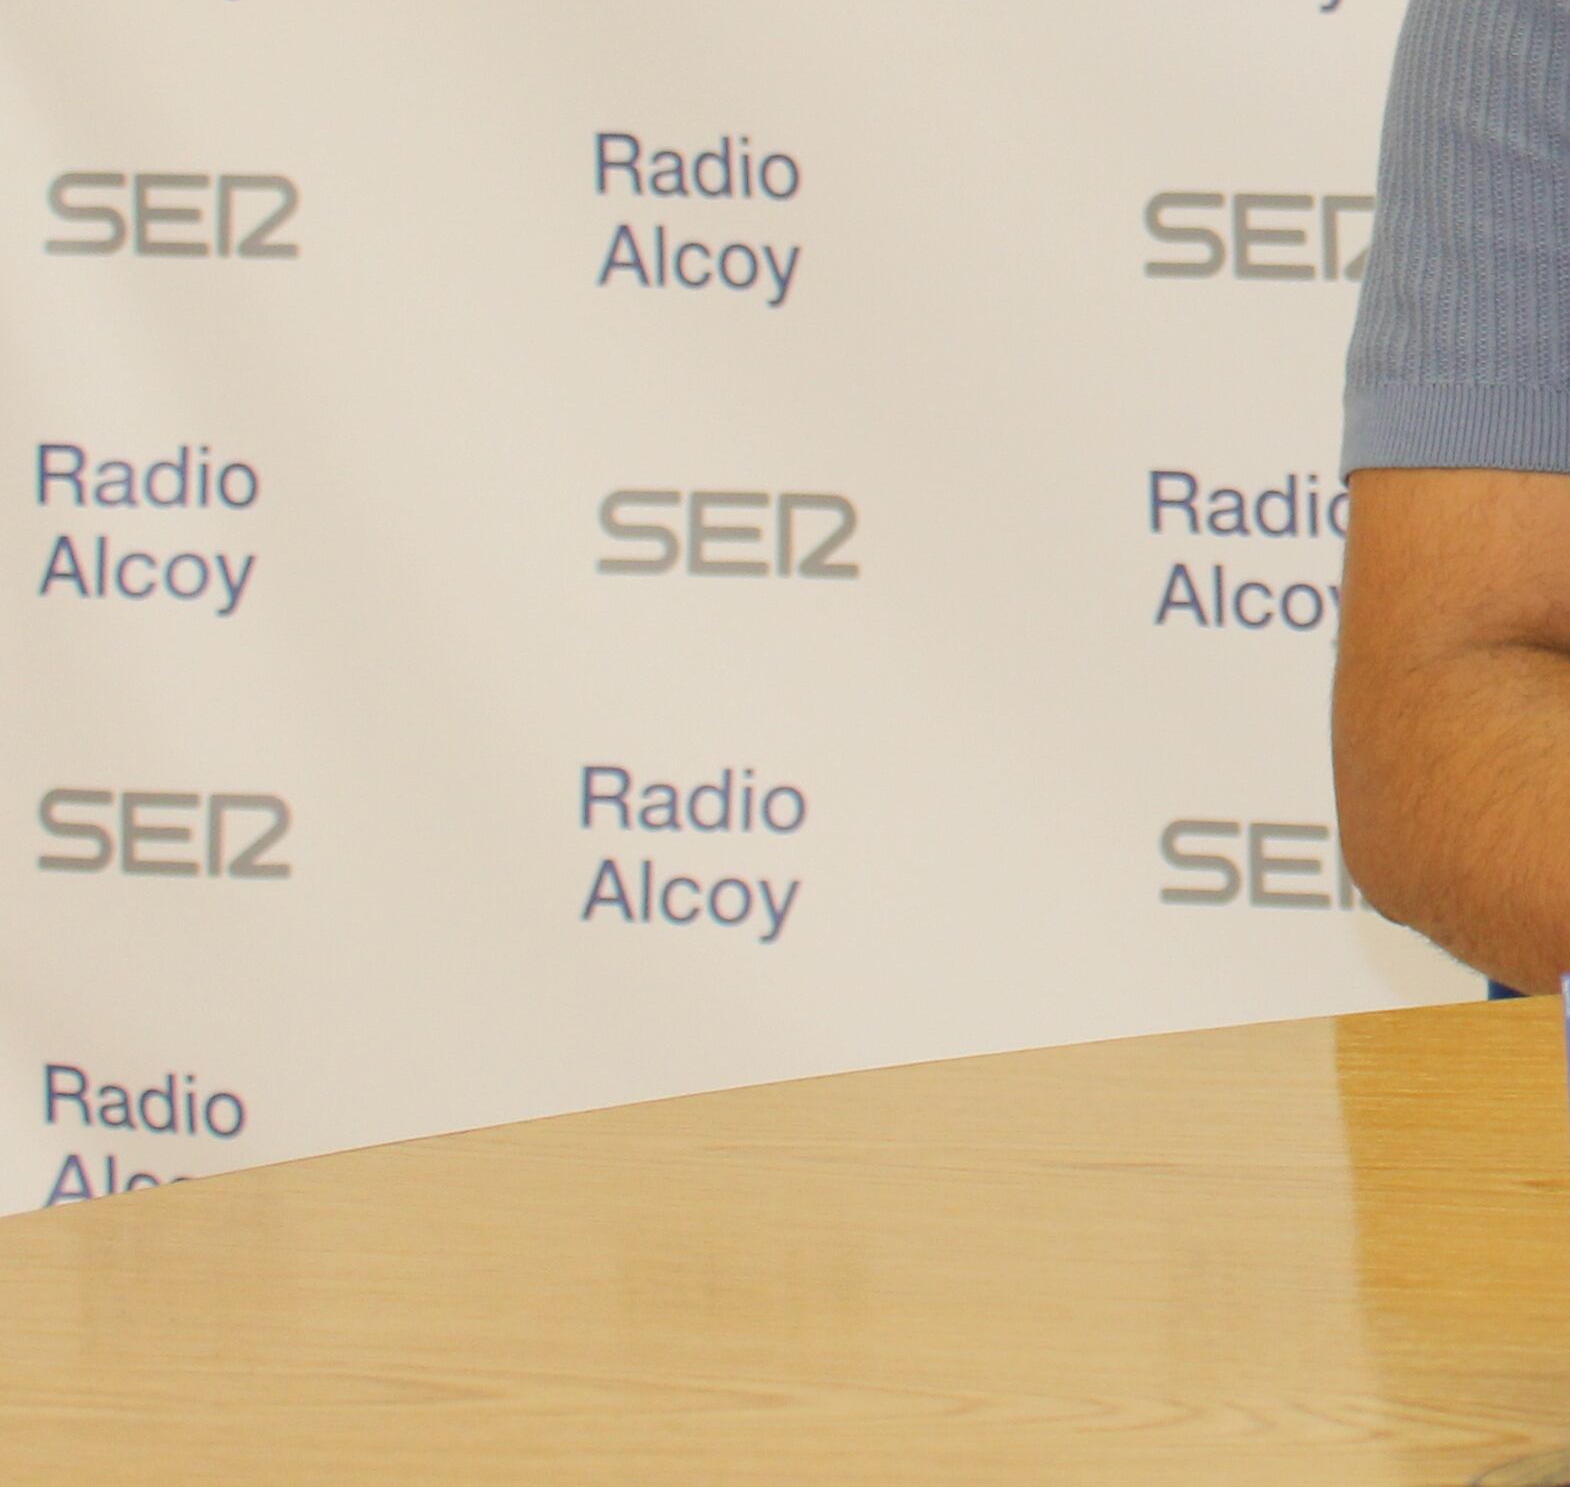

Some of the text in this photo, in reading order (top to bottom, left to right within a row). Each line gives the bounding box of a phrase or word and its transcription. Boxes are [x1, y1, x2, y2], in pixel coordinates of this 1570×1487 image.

[595, 131, 801, 200] Radio
[45, 171, 299, 258] SER
[598, 223, 801, 308] Alcoy
[37, 442, 259, 509] Radio
[39, 534, 256, 617] Alcoy
[597, 489, 859, 579] SER
[1154, 562, 1341, 650] Alco
[37, 787, 291, 878] SER
[581, 765, 807, 833] Radio
[581, 858, 800, 943] Alcoy
[1160, 818, 1378, 912] SE
[44, 1063, 246, 1138] Radio
